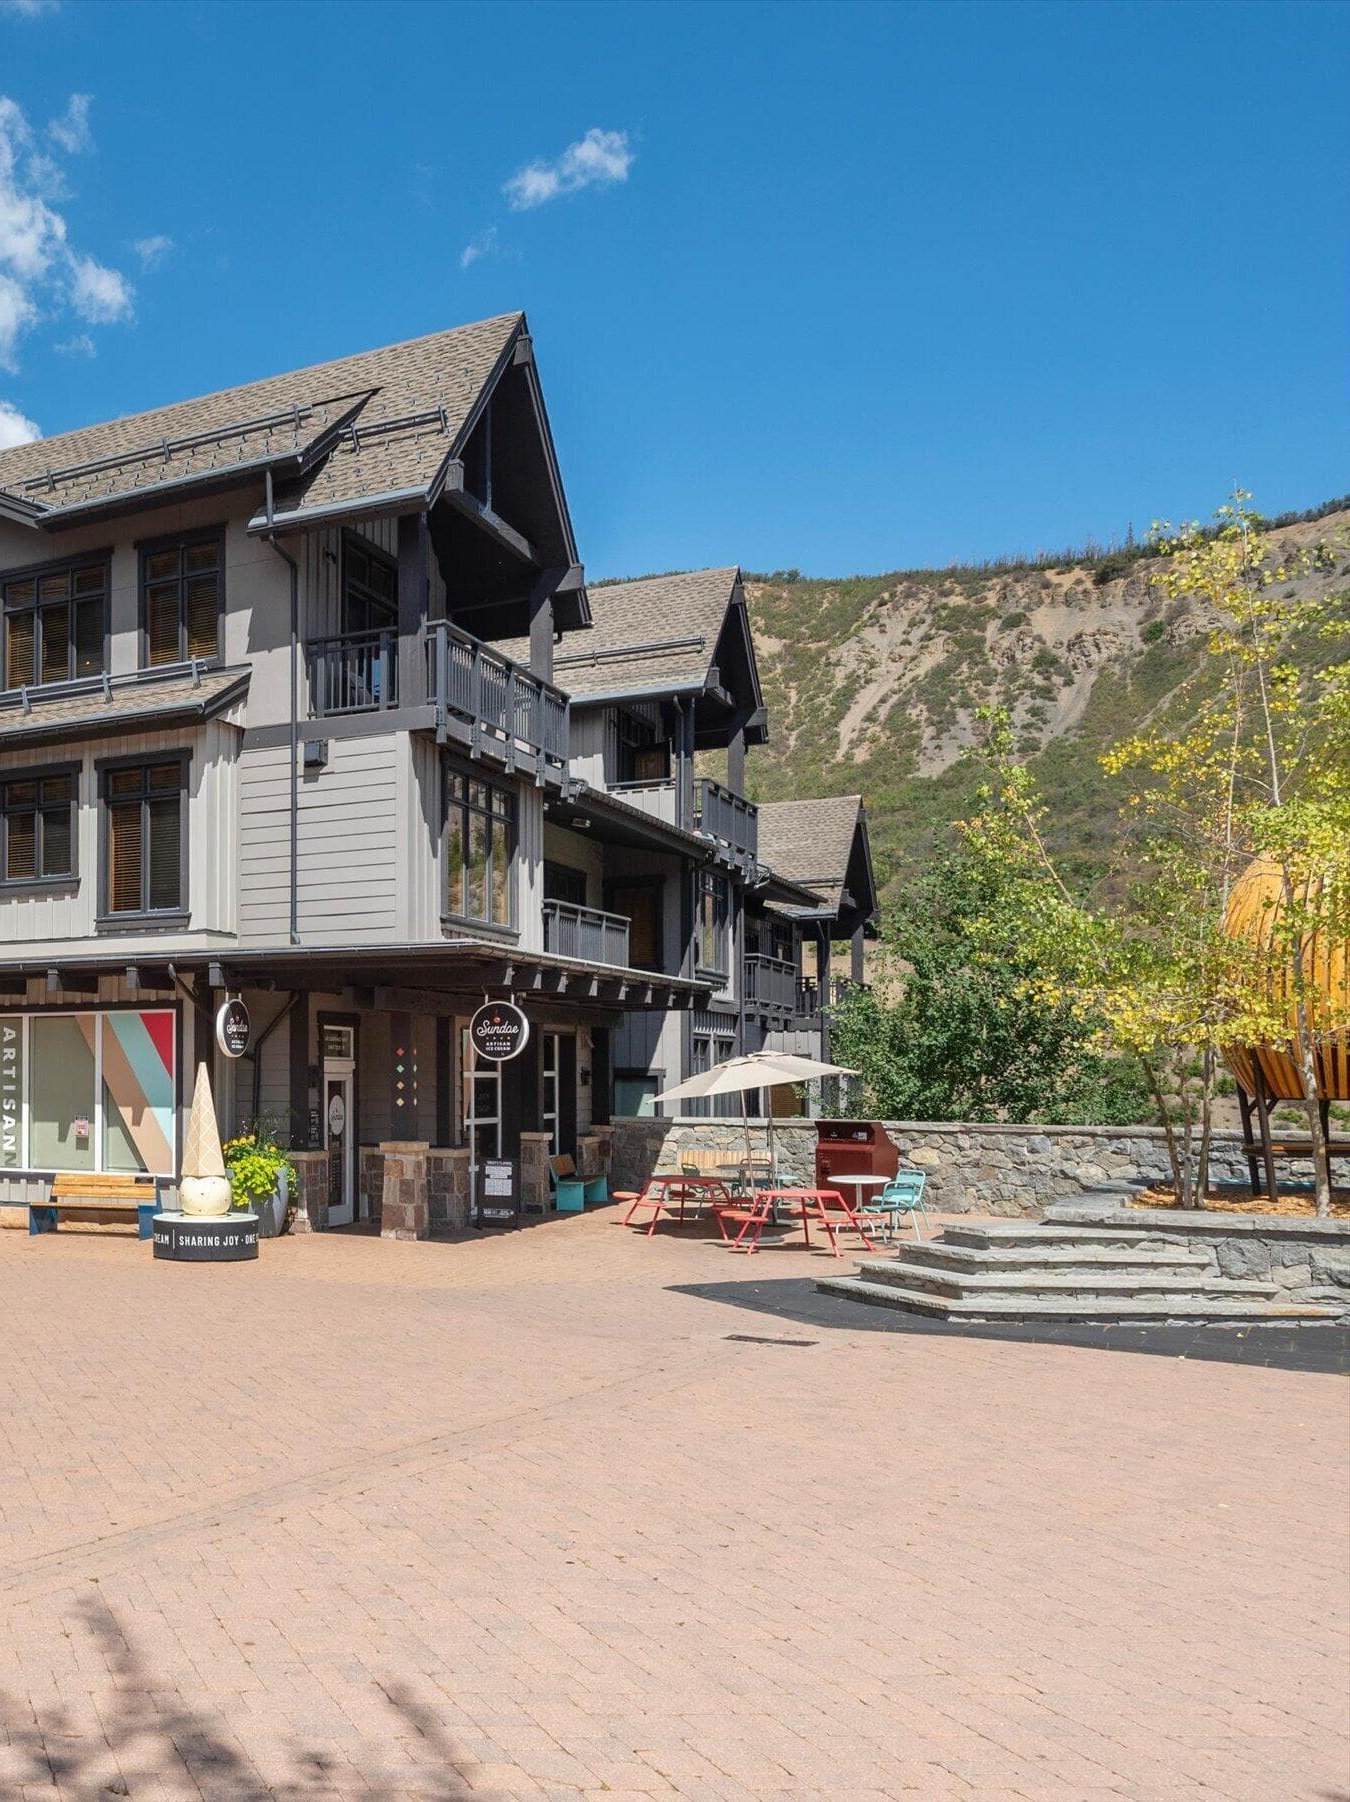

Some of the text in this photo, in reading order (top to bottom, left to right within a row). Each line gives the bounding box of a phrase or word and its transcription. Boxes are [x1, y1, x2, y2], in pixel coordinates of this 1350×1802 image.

[476, 1019, 520, 1037] Sundae
[3, 1026, 17, 1151] ARTISAN
[179, 1235, 220, 1247] SHARING
[223, 1235, 240, 1247] JOY
